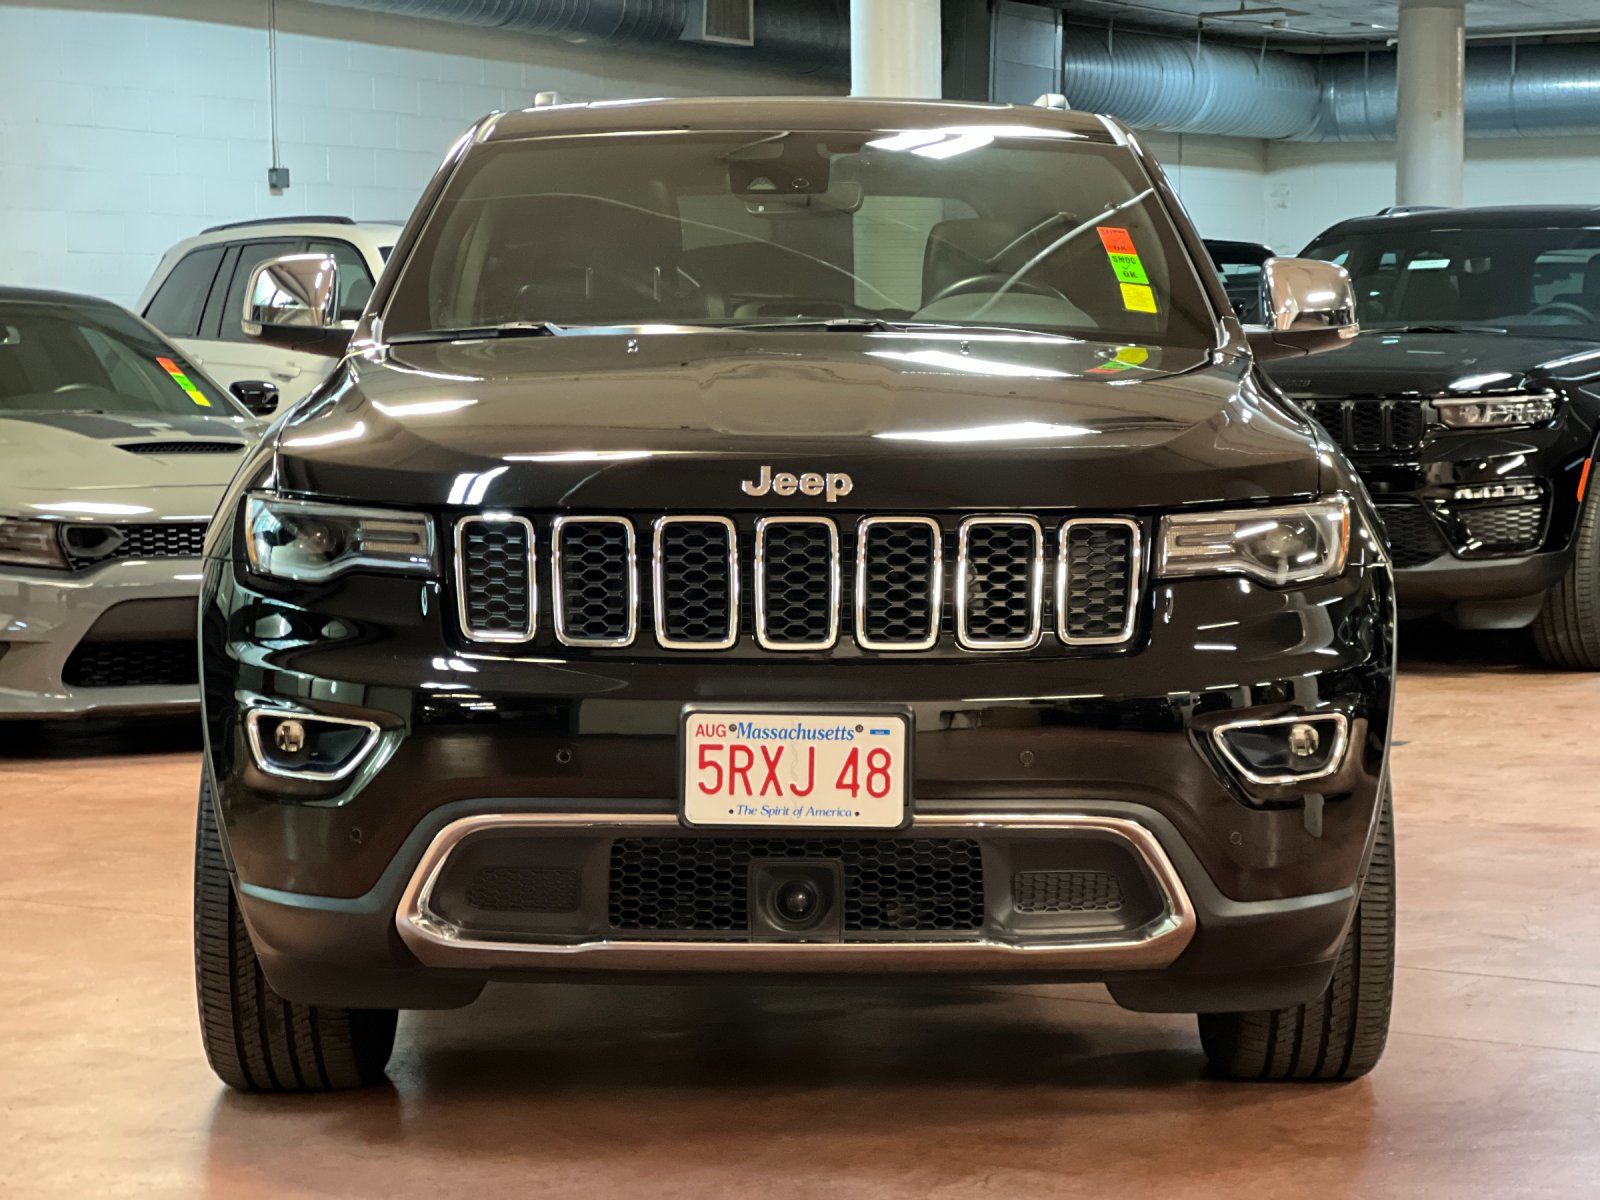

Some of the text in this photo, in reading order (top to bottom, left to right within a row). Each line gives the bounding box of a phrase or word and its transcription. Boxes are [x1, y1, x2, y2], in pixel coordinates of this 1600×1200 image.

[742, 465, 853, 502] Jeep
[695, 724, 727, 738] AUG
[736, 722, 855, 741] Massachusetts
[698, 744, 892, 798] 5RXJ 48
[737, 804, 852, 818] The Spirit of America
